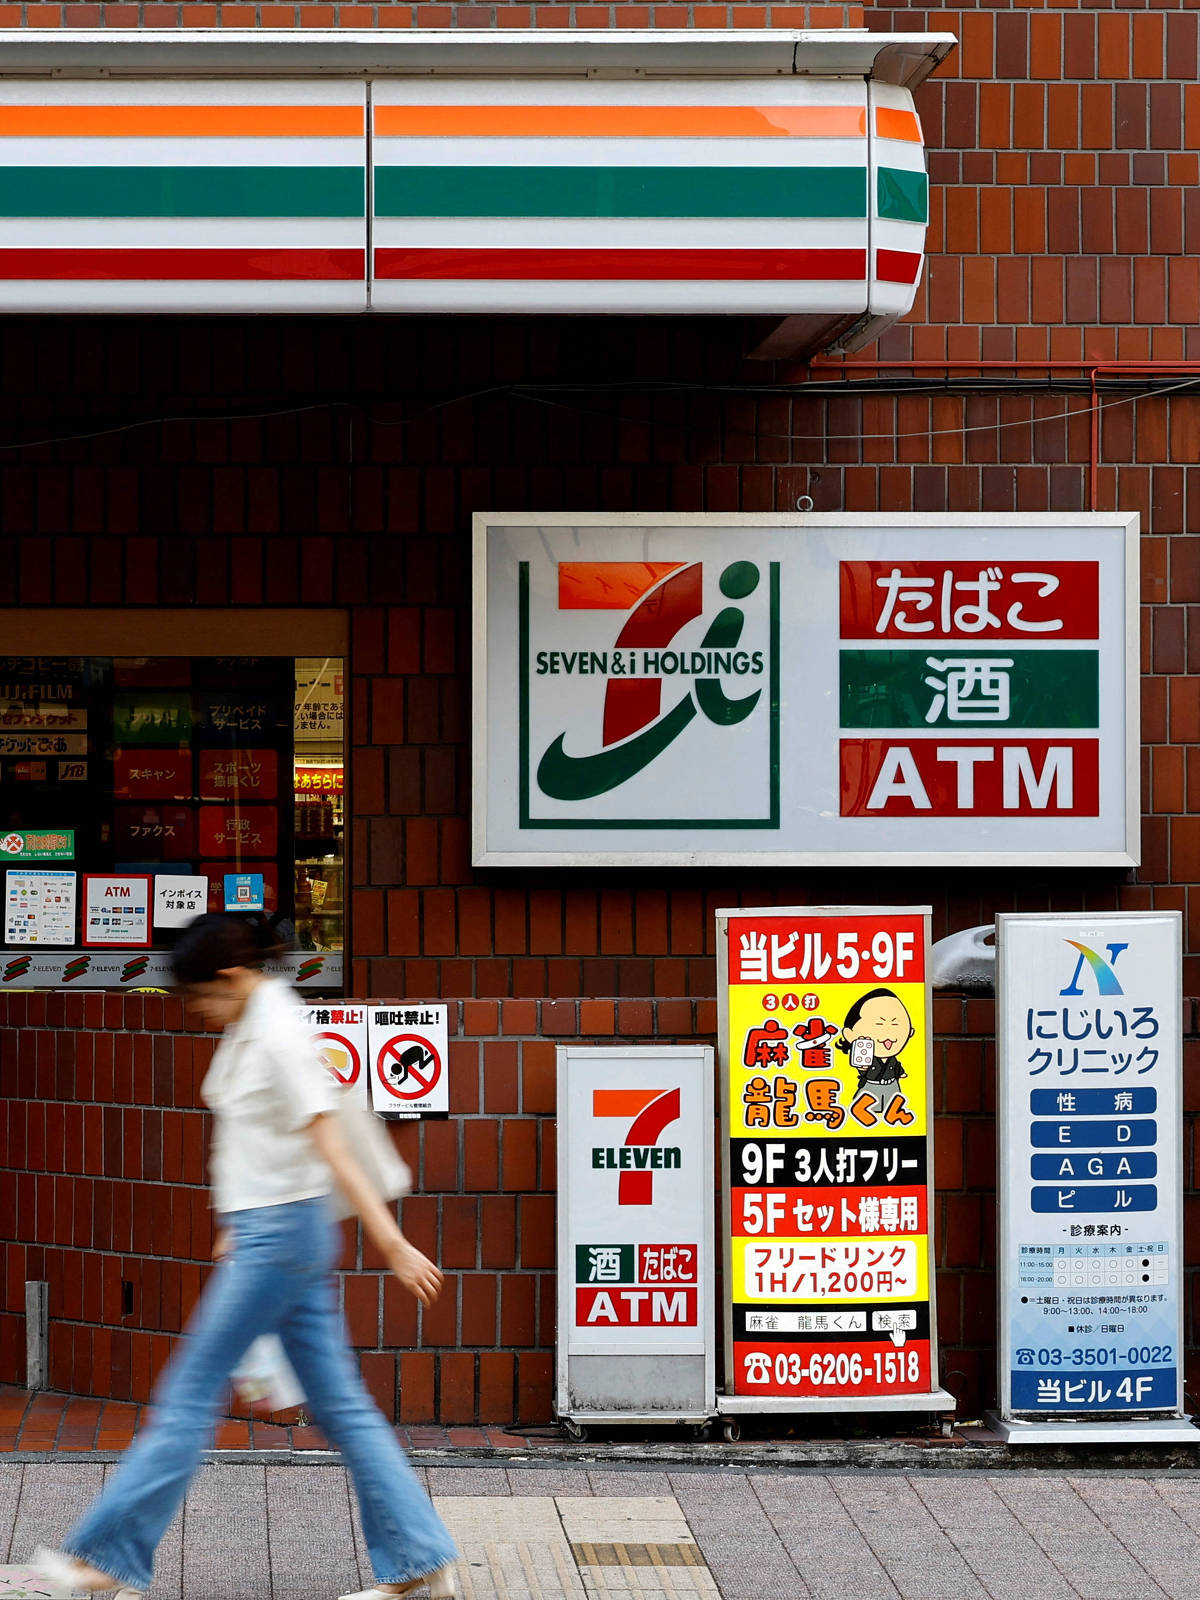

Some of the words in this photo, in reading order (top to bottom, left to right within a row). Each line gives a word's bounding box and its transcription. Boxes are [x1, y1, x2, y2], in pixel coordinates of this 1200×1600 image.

[875, 566, 1064, 634] たばこ
[643, 650, 764, 677] HOLDINGS
[924, 656, 1015, 724] 酒
[129, 769, 176, 780] スキャン
[866, 745, 1074, 810] ATM
[130, 825, 176, 837] ファクス
[104, 886, 131, 897] ATM
[160, 889, 203, 899] インボイス
[165, 901, 196, 910] 対象店
[764, 994, 819, 1010] 3人打
[299, 1010, 364, 1025] イ捨禁止!
[1027, 1007, 1160, 1041] にじいろ
[744, 1018, 839, 1068] 麻雀
[1027, 1047, 1160, 1076] クリニック
[743, 1076, 915, 1129] 龍馬くん
[741, 1143, 786, 1184] 9F
[794, 1147, 918, 1183] 3人打フリー
[742, 1193, 787, 1234] 5F
[792, 1196, 919, 1233] セット様専用
[588, 1247, 622, 1281] 酒
[643, 1247, 693, 1281] たばこ
[754, 1246, 906, 1269] フリードリンク
[1109, 1246, 1117, 1254] 木
[587, 1292, 688, 1323] ATM
[749, 1315, 779, 1330] 麻雀
[797, 1315, 862, 1330] 龍馬くん
[877, 1314, 910, 1329] 検索
[774, 1351, 920, 1384] 03-6206-1518
[1038, 1345, 1172, 1366] 03-3501-0022
